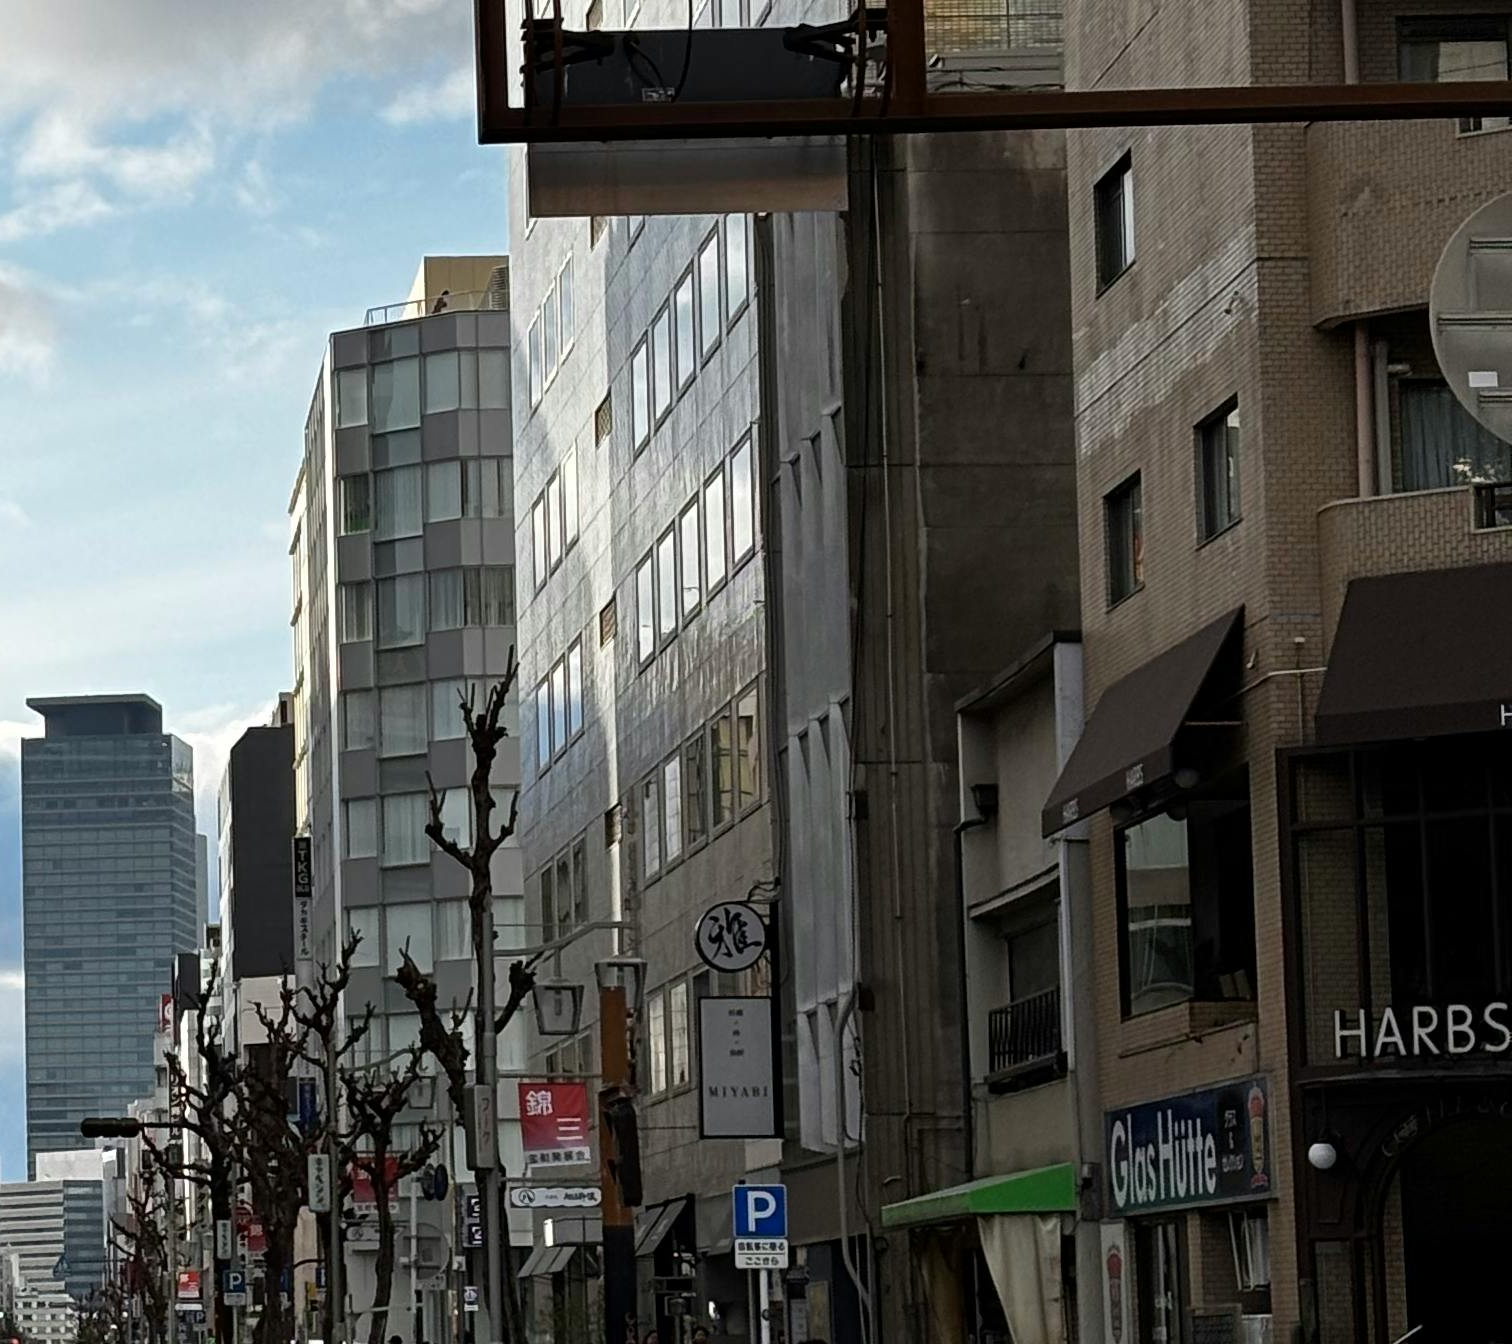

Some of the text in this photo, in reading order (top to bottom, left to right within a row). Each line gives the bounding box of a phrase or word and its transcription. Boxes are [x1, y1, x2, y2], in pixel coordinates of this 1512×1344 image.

[1333, 1001, 1512, 1059] HARBS
[708, 1085, 769, 1099] MIYABI
[746, 1190, 777, 1233] P
